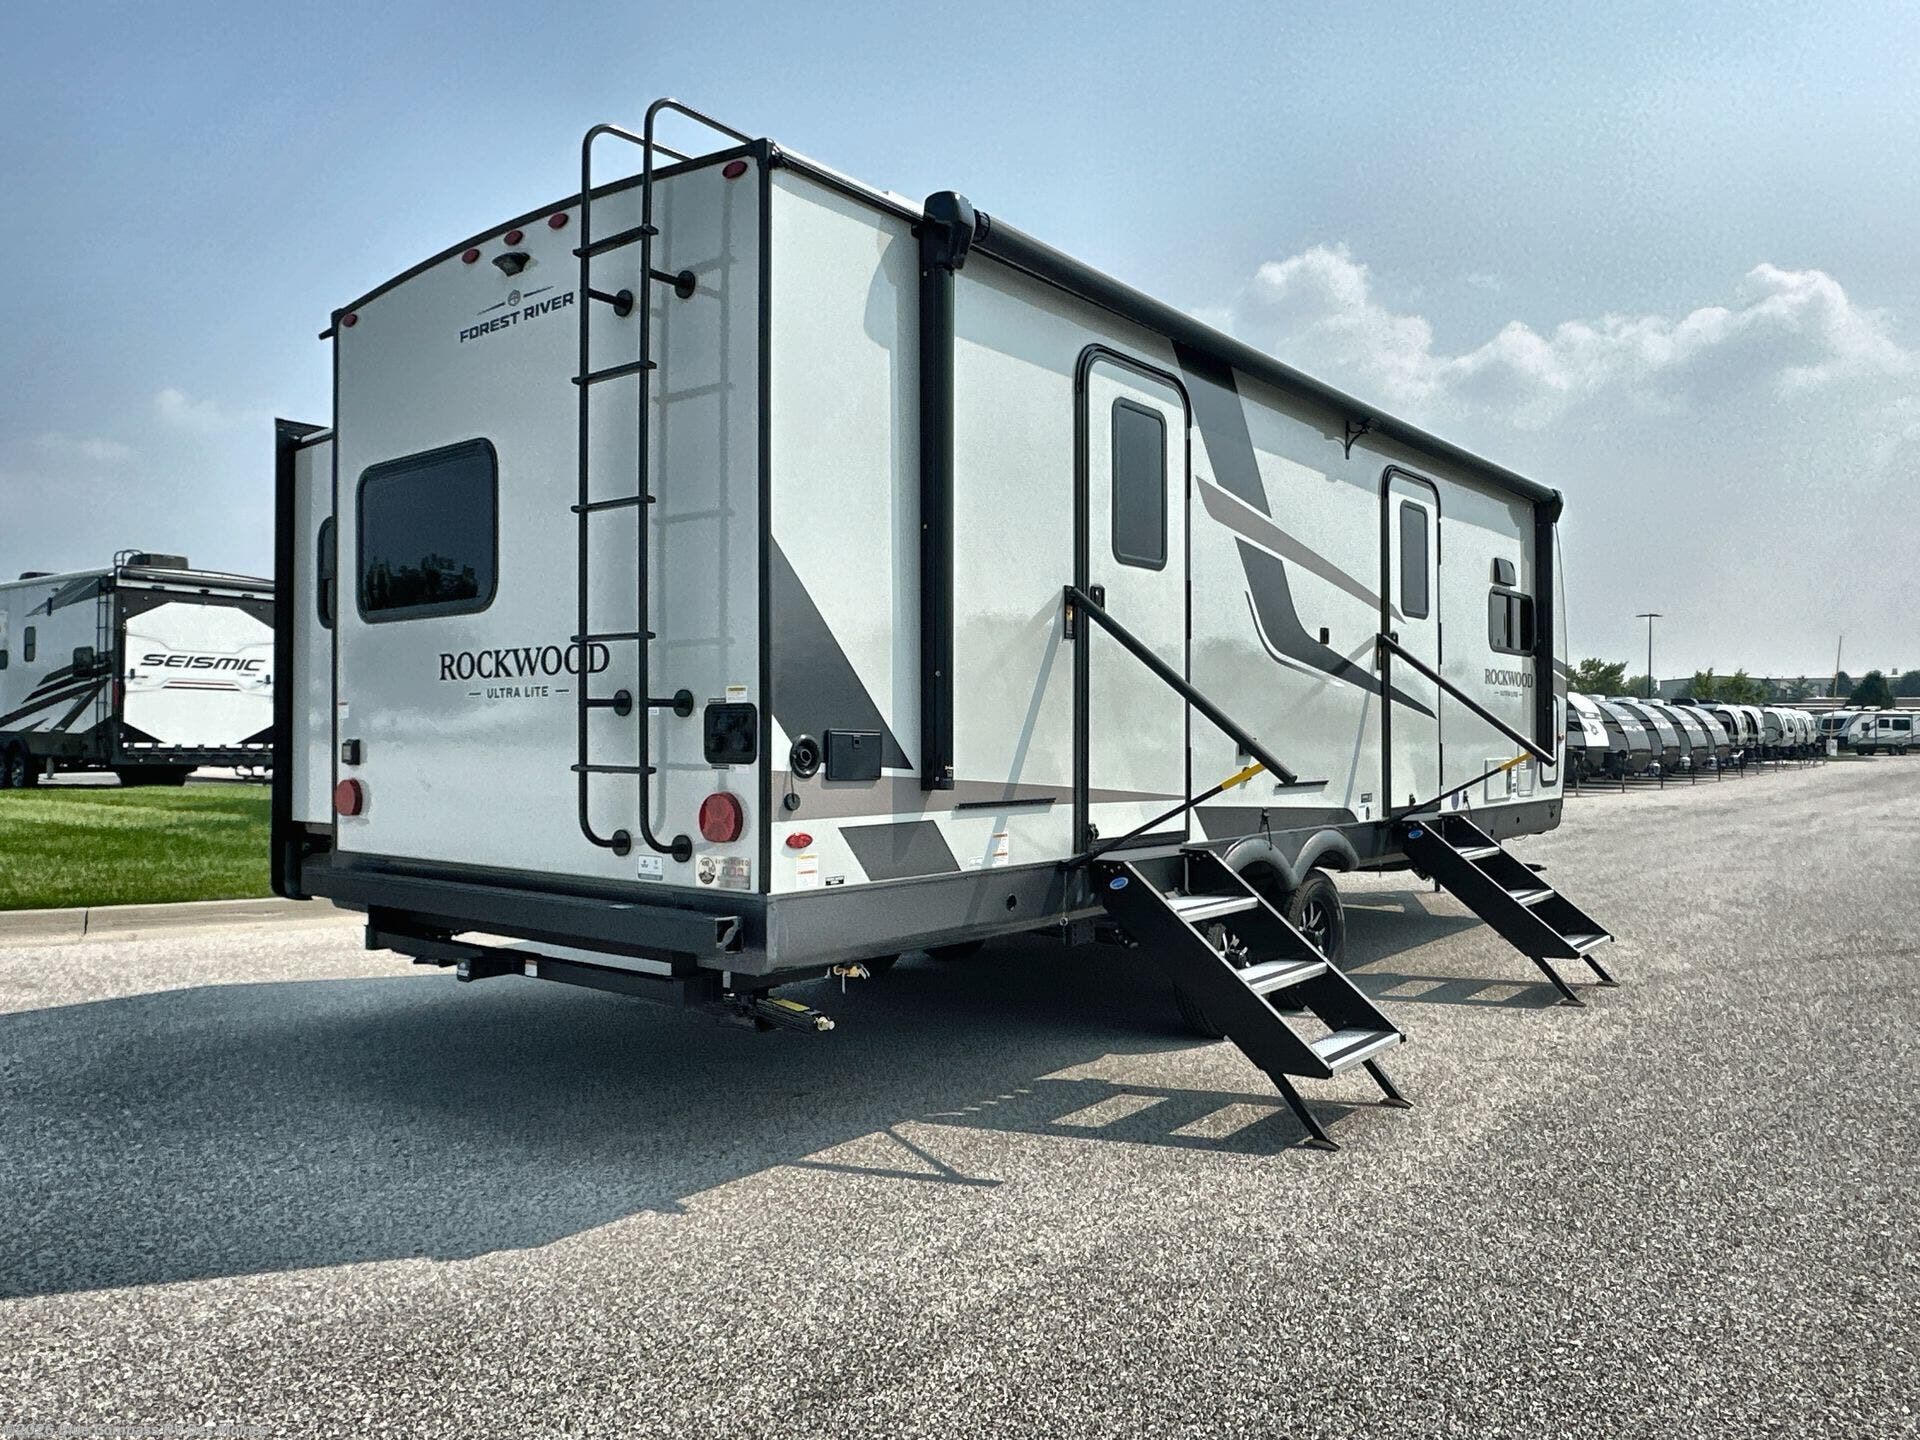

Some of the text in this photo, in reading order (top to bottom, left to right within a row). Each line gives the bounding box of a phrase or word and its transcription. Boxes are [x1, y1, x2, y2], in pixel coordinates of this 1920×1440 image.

[460, 292, 574, 343] FOREST RIVER
[140, 654, 265, 671] SEISMIC
[439, 643, 610, 681] ROCKWOOD
[1484, 668, 1533, 688] ROCKWOOD
[486, 686, 549, 699] ULTRA LITE
